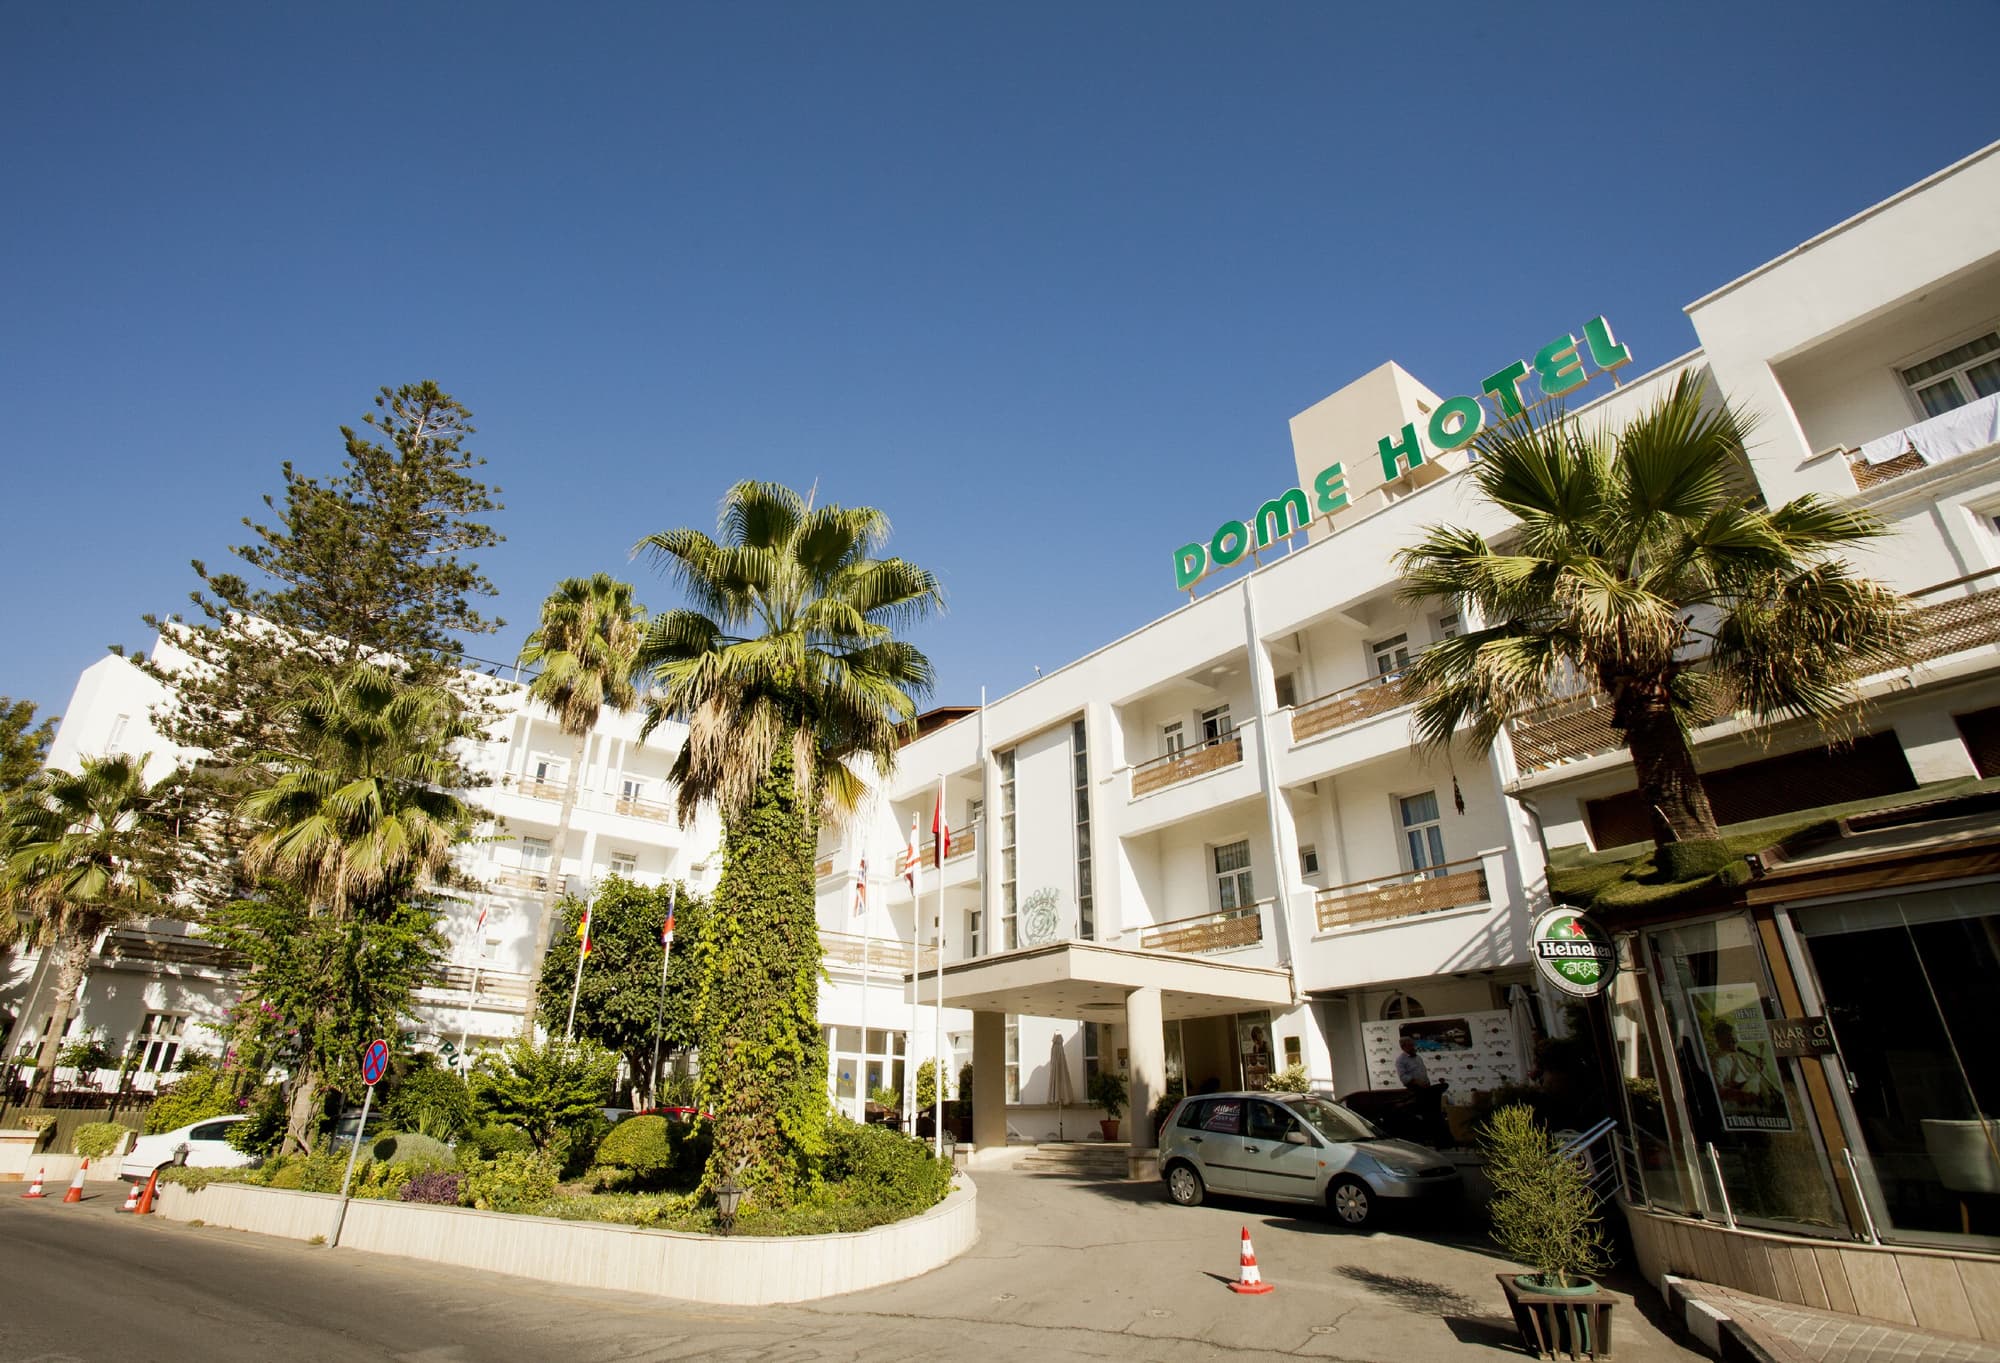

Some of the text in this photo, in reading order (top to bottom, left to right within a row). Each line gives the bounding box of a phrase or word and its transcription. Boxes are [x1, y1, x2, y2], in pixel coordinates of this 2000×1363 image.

[1173, 315, 1633, 592] DOME HOTEL
[1541, 941, 1612, 958] Heineken
